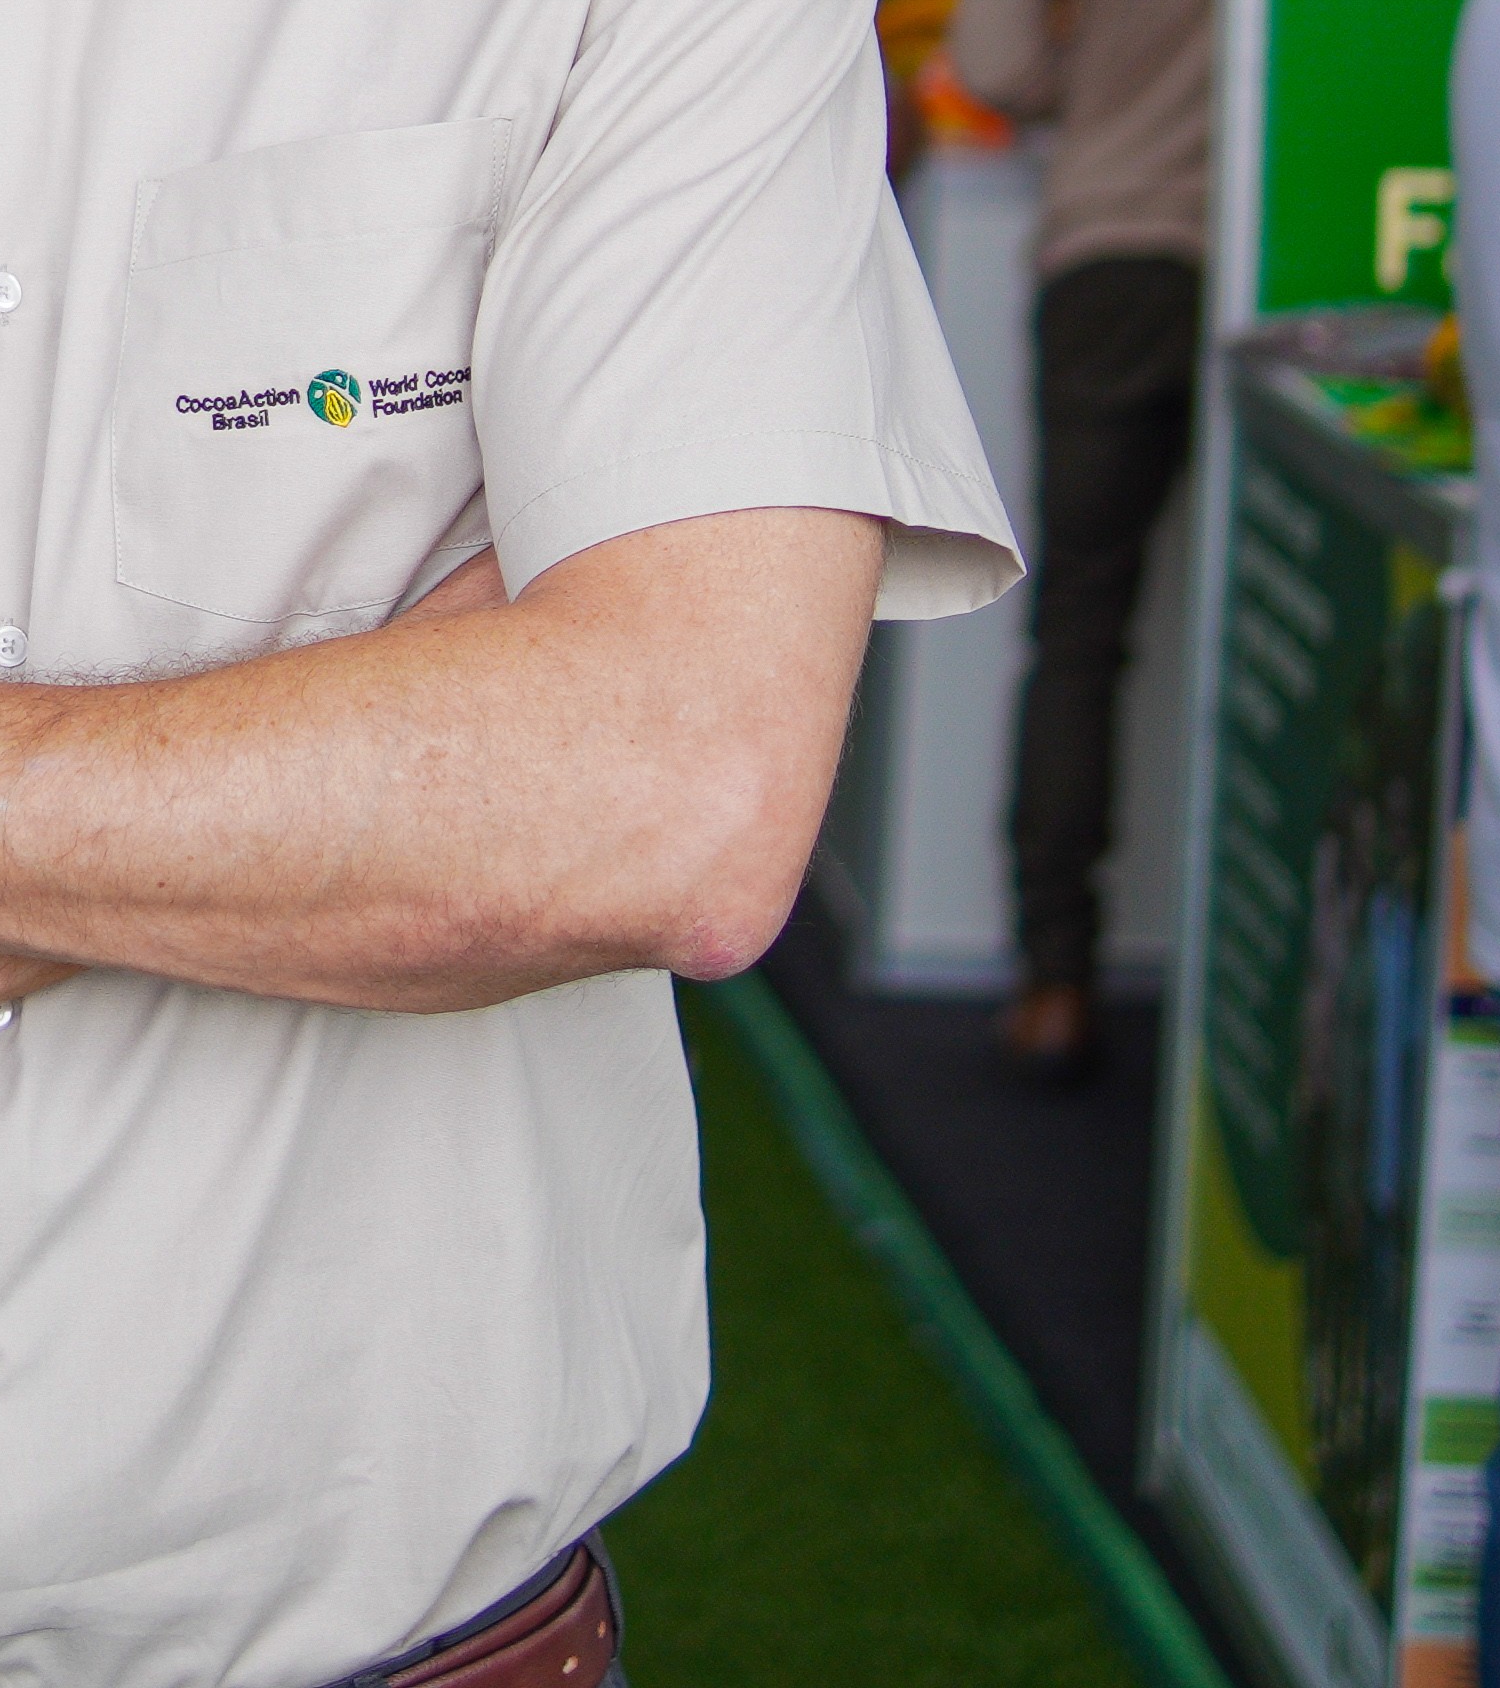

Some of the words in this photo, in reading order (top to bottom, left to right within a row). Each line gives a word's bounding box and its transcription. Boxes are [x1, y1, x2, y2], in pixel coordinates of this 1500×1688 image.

[369, 373, 420, 398] World
[175, 387, 302, 415] CocoaAction
[372, 387, 465, 418] Foundation
[211, 410, 271, 432] Brasil
